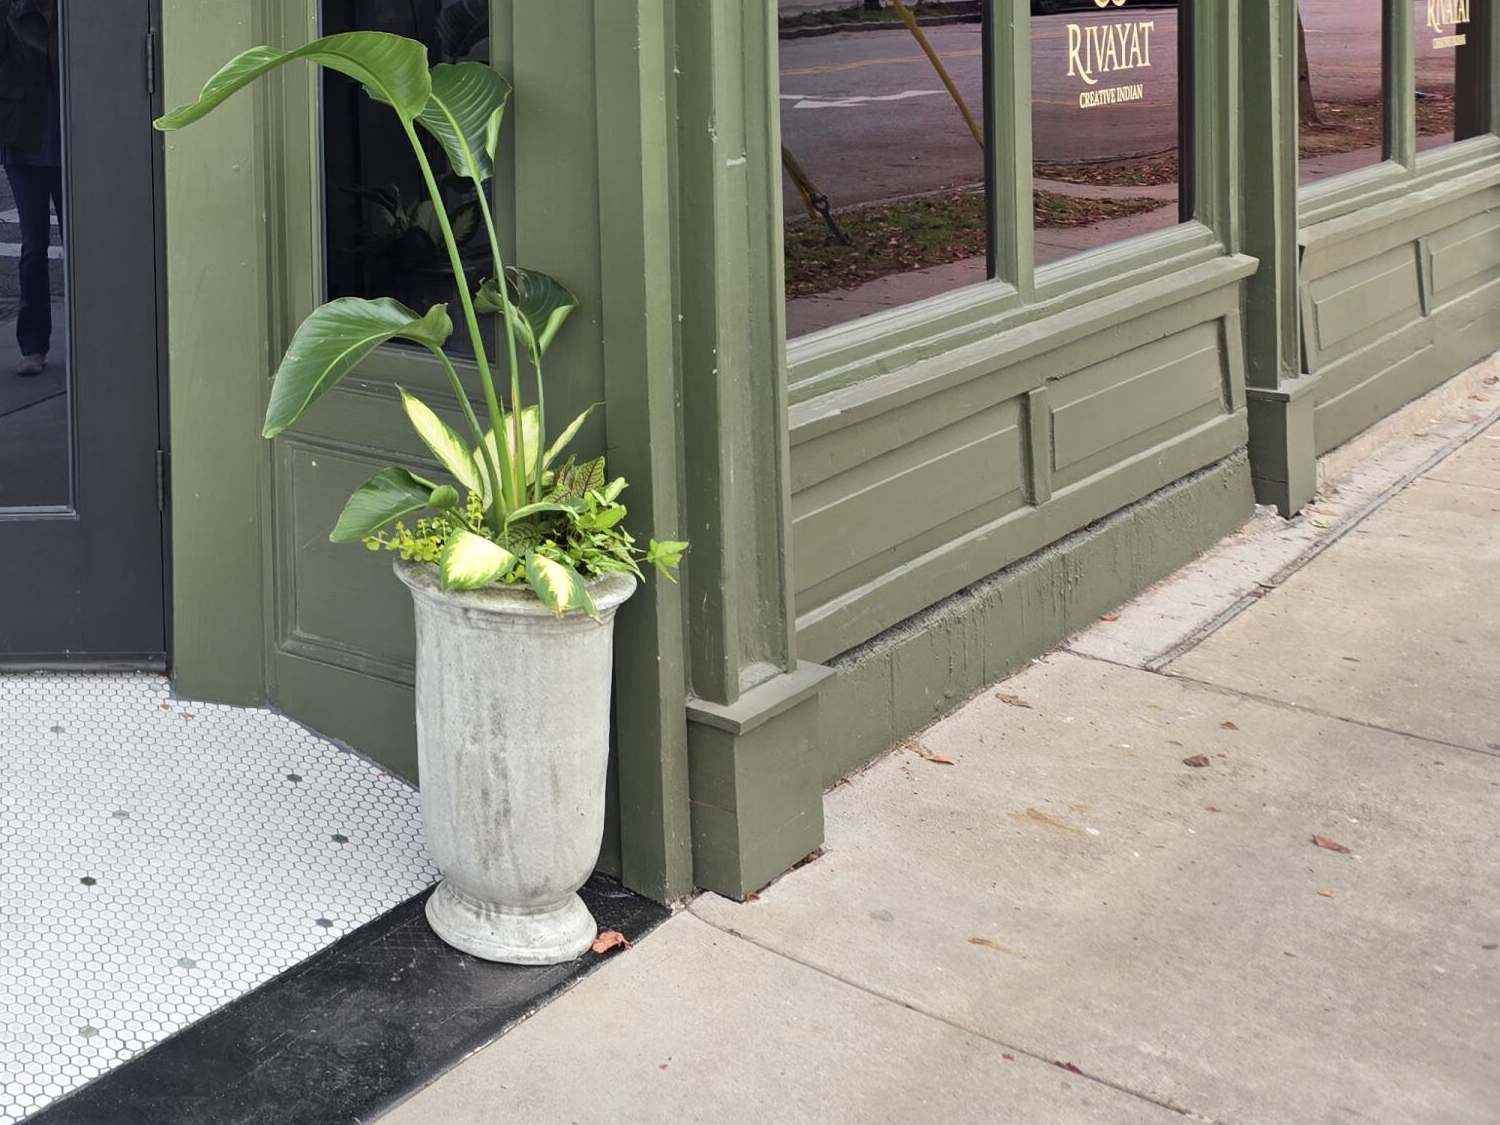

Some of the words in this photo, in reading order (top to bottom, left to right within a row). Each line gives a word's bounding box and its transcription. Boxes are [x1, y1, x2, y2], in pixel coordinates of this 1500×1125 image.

[1066, 22, 1154, 85] RIVAYAT
[1079, 88, 1116, 108] CREATIVE
[1117, 84, 1143, 101] INDIAN
